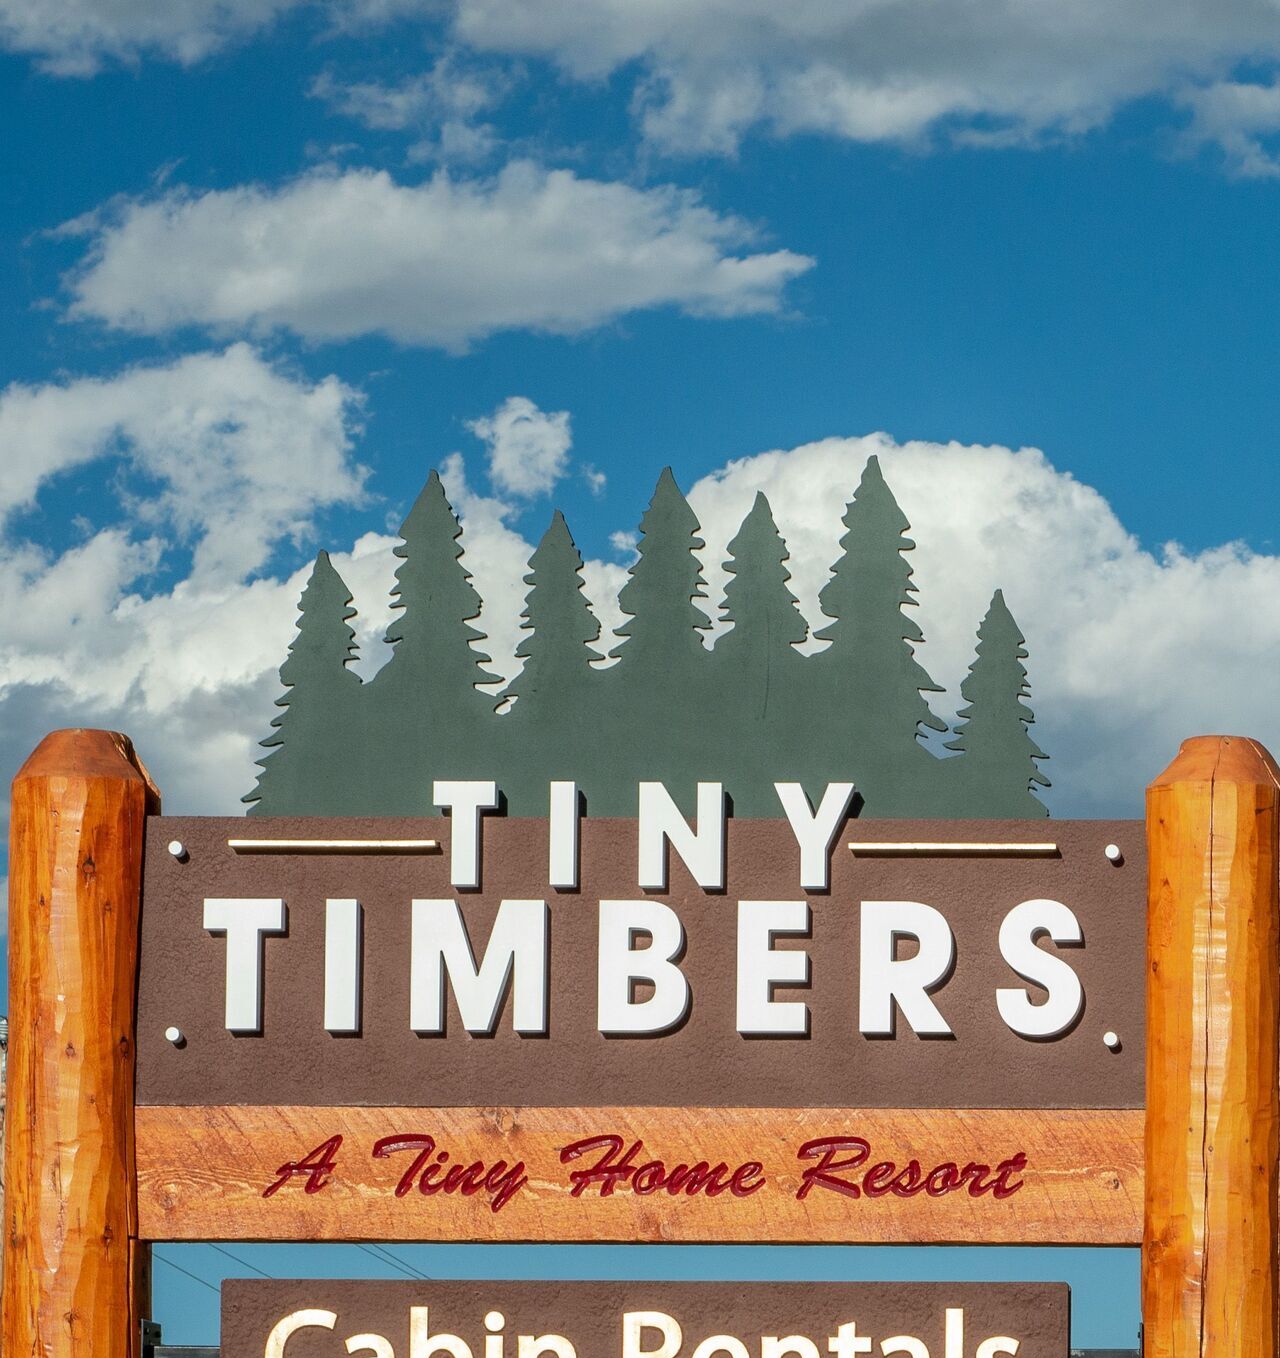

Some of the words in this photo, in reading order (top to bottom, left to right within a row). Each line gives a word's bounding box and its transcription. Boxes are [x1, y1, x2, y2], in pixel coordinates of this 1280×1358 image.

[432, 780, 856, 891] TINY
[203, 898, 1083, 1036] TIMBERS
[263, 1133, 344, 1199] A
[371, 1133, 529, 1213] Tiny
[559, 1133, 767, 1198] Home
[795, 1134, 1029, 1202] Resort
